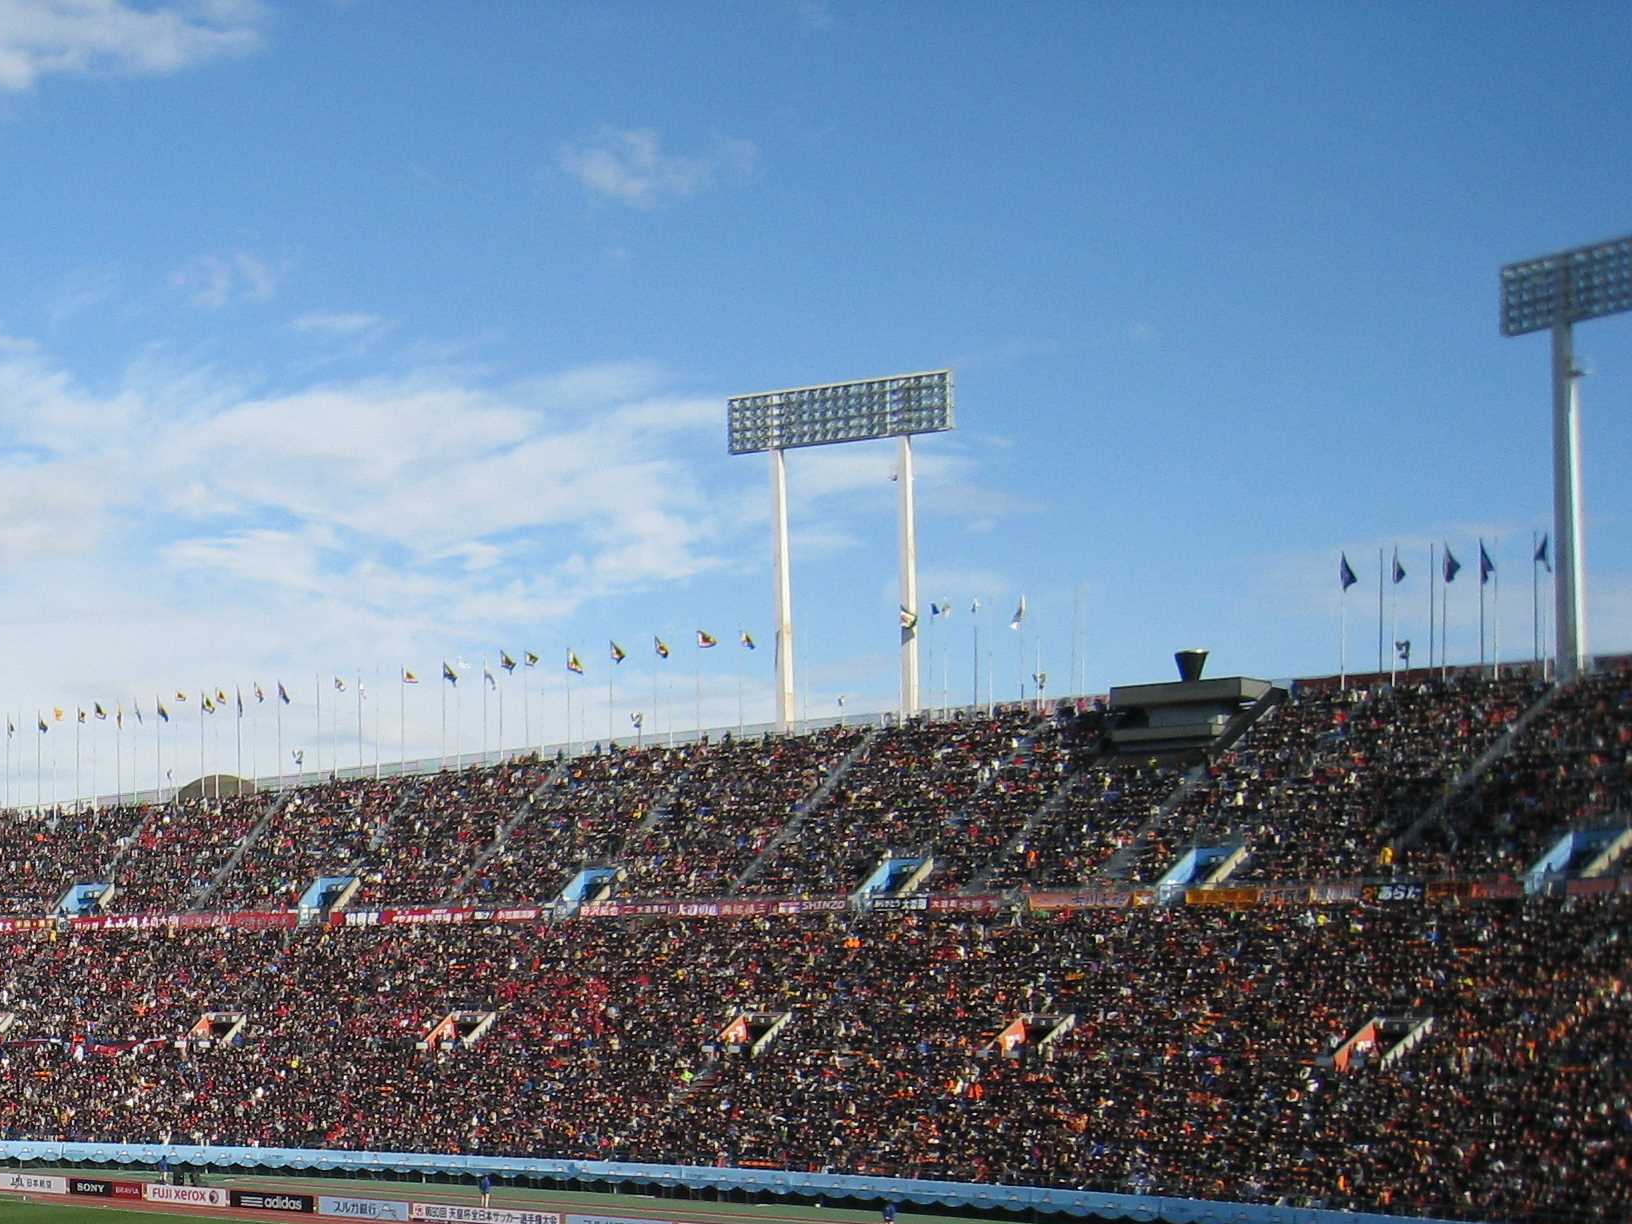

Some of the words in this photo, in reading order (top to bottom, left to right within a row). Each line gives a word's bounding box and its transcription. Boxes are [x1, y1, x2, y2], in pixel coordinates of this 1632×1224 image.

[76, 1182, 105, 1193] SONY
[152, 1187, 173, 1199] FUJI
[174, 1188, 206, 1202] xerox
[264, 1197, 303, 1210] adidas
[334, 1200, 377, 1215] スルガ銀行
